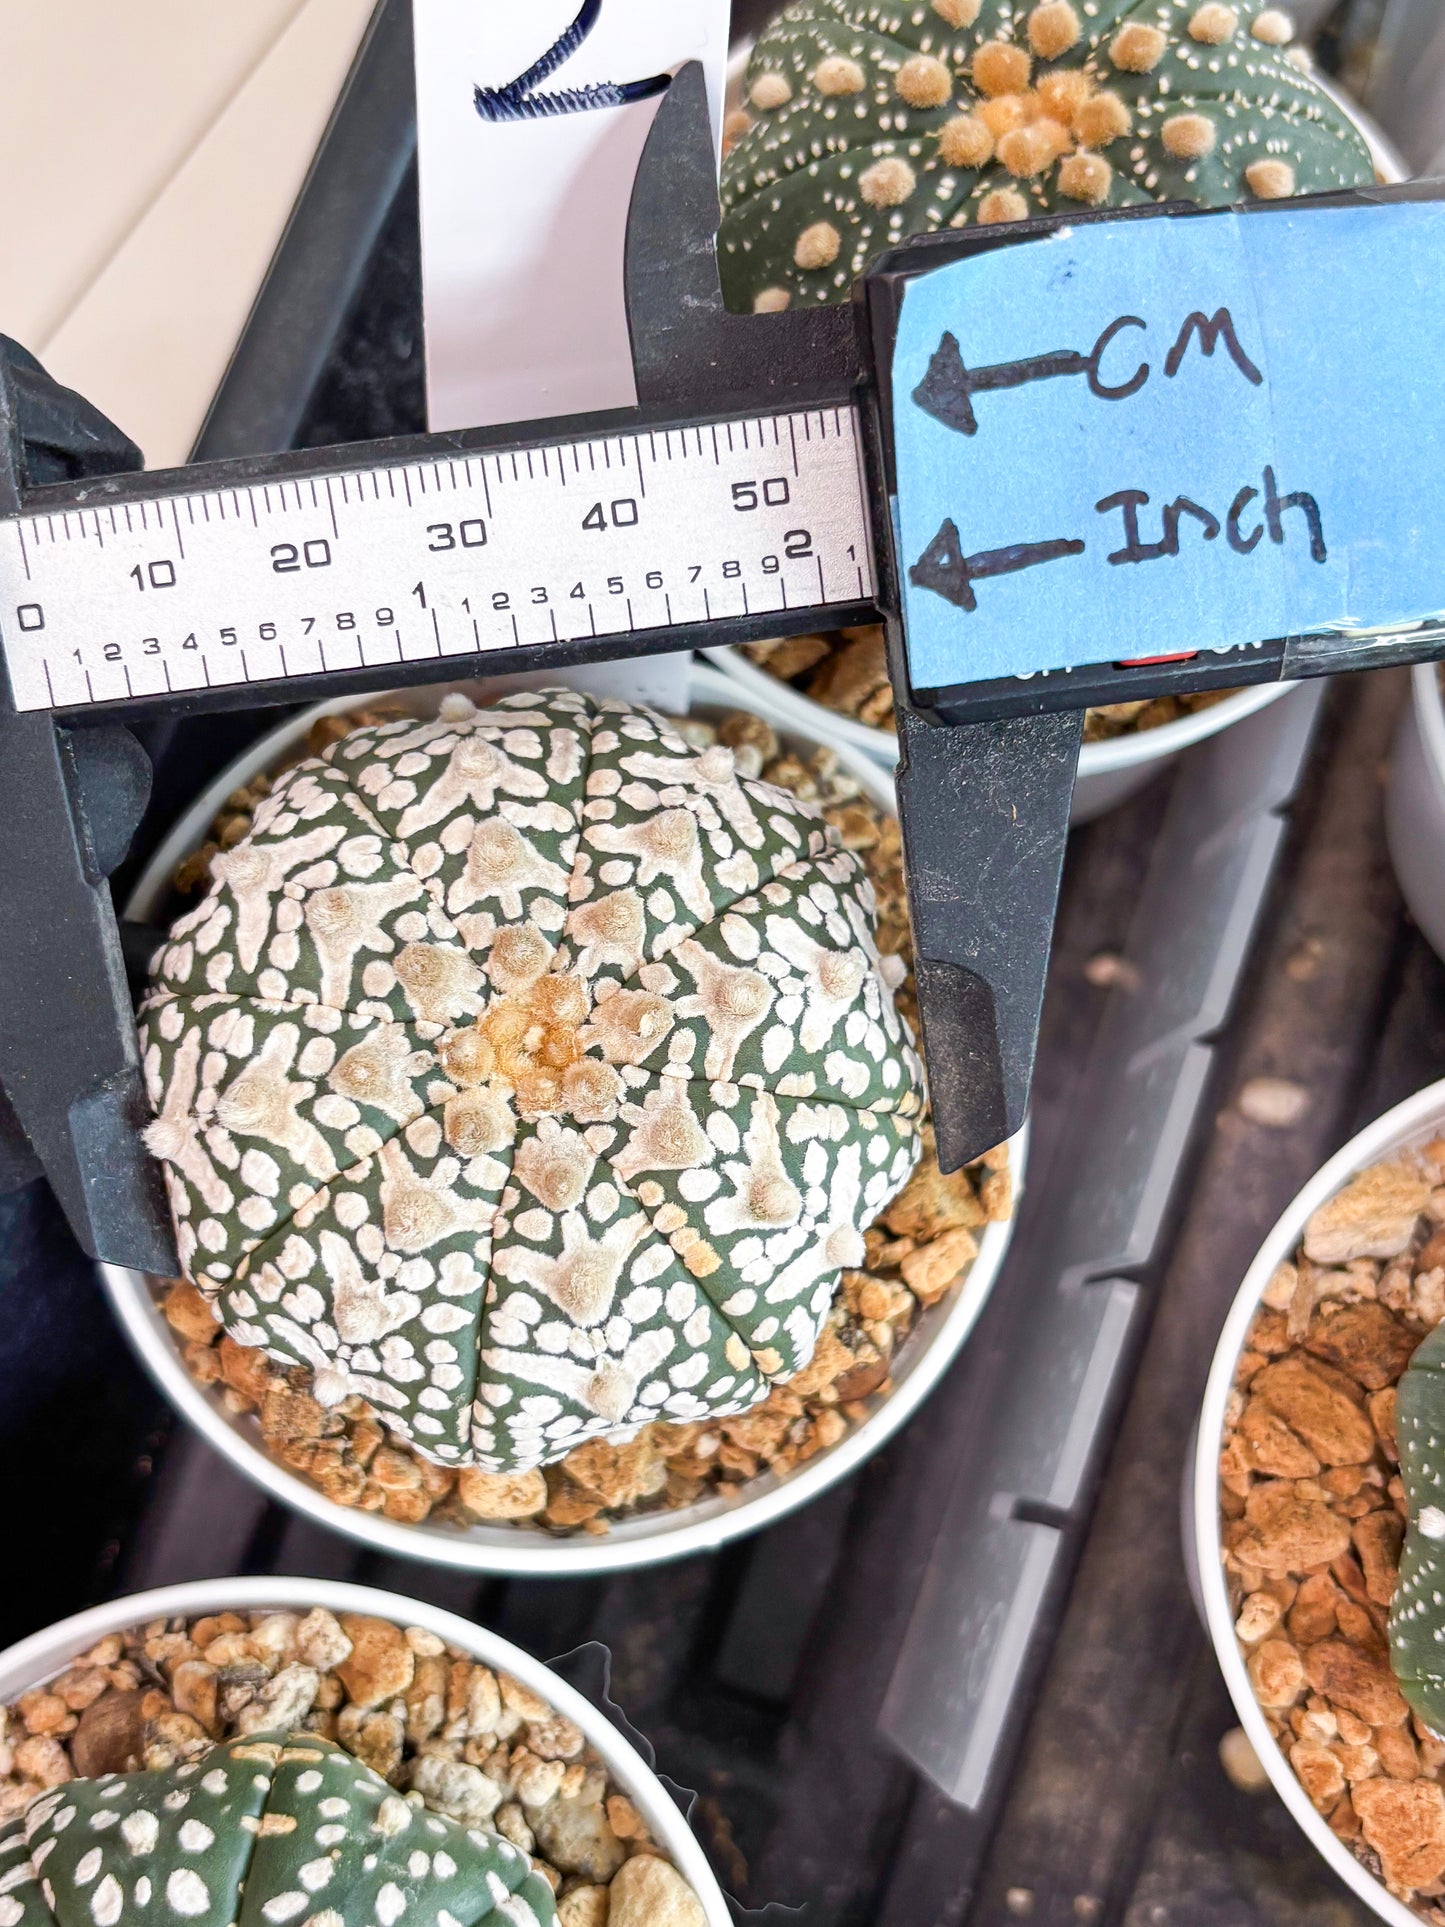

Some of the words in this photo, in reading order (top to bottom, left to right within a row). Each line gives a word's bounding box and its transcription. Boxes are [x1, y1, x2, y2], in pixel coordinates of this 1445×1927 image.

[17, 604, 45, 632] 0
[130, 560, 177, 592] 10
[270, 540, 332, 573] 20
[427, 519, 488, 552] 30
[582, 499, 639, 532] 40
[732, 477, 790, 512] 50
[1095, 464, 1327, 564] Inch
[73, 649, 83, 665] 1
[104, 643, 123, 661] 2
[142, 637, 161, 655] 3
[182, 633, 199, 651] 4
[220, 627, 237, 646] 5
[258, 622, 277, 641] 6
[300, 617, 316, 635] 7
[336, 612, 356, 631] 8
[375, 607, 395, 627] 9
[411, 582, 427, 609] 1
[461, 598, 470, 614] 1
[491, 592, 511, 610] 2
[531, 587, 549, 604] 3
[569, 582, 586, 599] 4
[607, 577, 624, 595] 5
[646, 571, 664, 590] 6
[687, 566, 702, 583] 7
[722, 560, 742, 579] 8
[761, 555, 780, 574] 9
[784, 529, 813, 559] 2
[847, 545, 856, 562] 1
